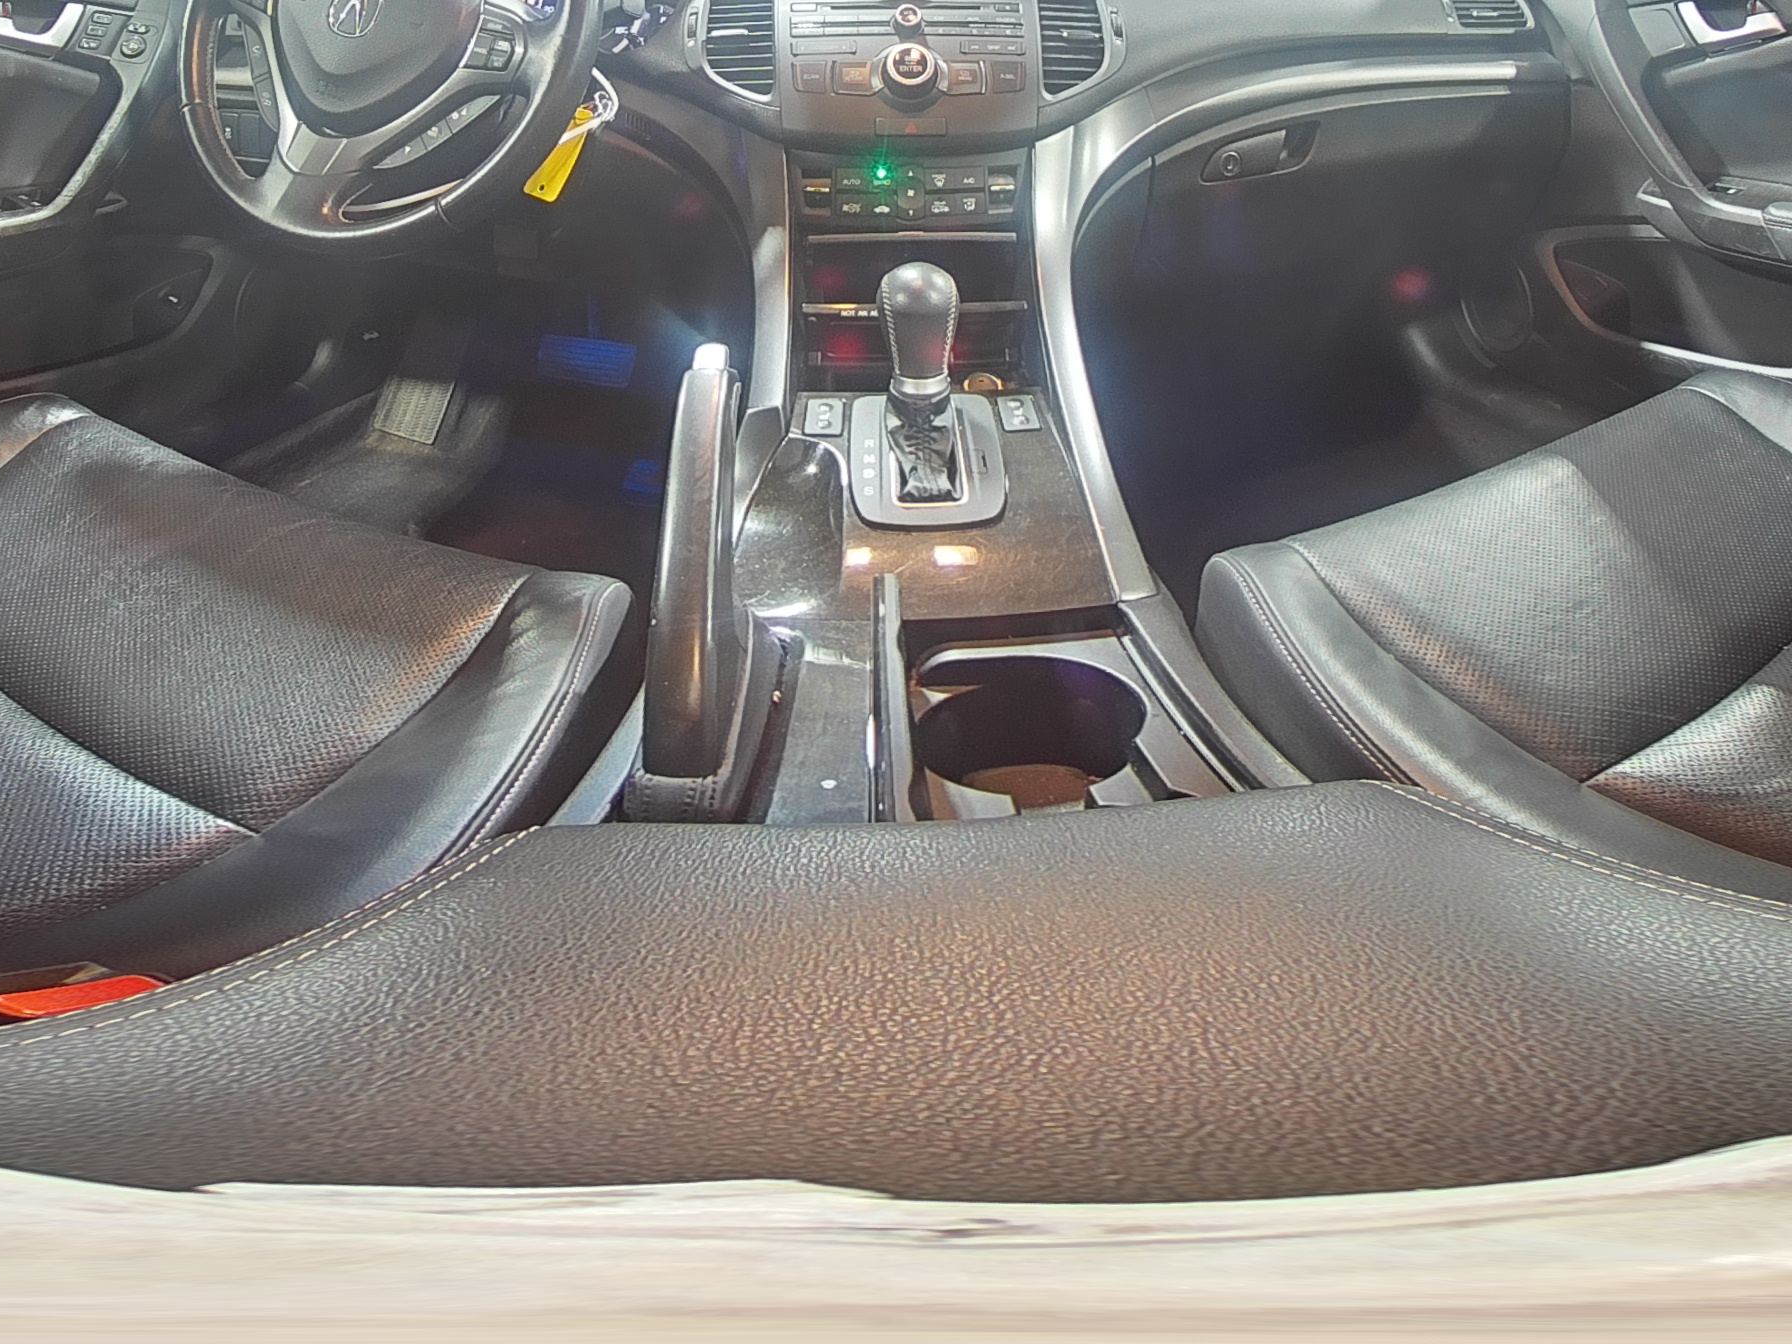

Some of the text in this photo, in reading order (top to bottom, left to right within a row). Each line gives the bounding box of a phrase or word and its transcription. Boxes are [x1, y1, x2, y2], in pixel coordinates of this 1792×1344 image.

[840, 309, 856, 317] NOT
[864, 439, 875, 449] R
[863, 454, 876, 464] N
[862, 468, 876, 479] D
[863, 485, 875, 496] S
